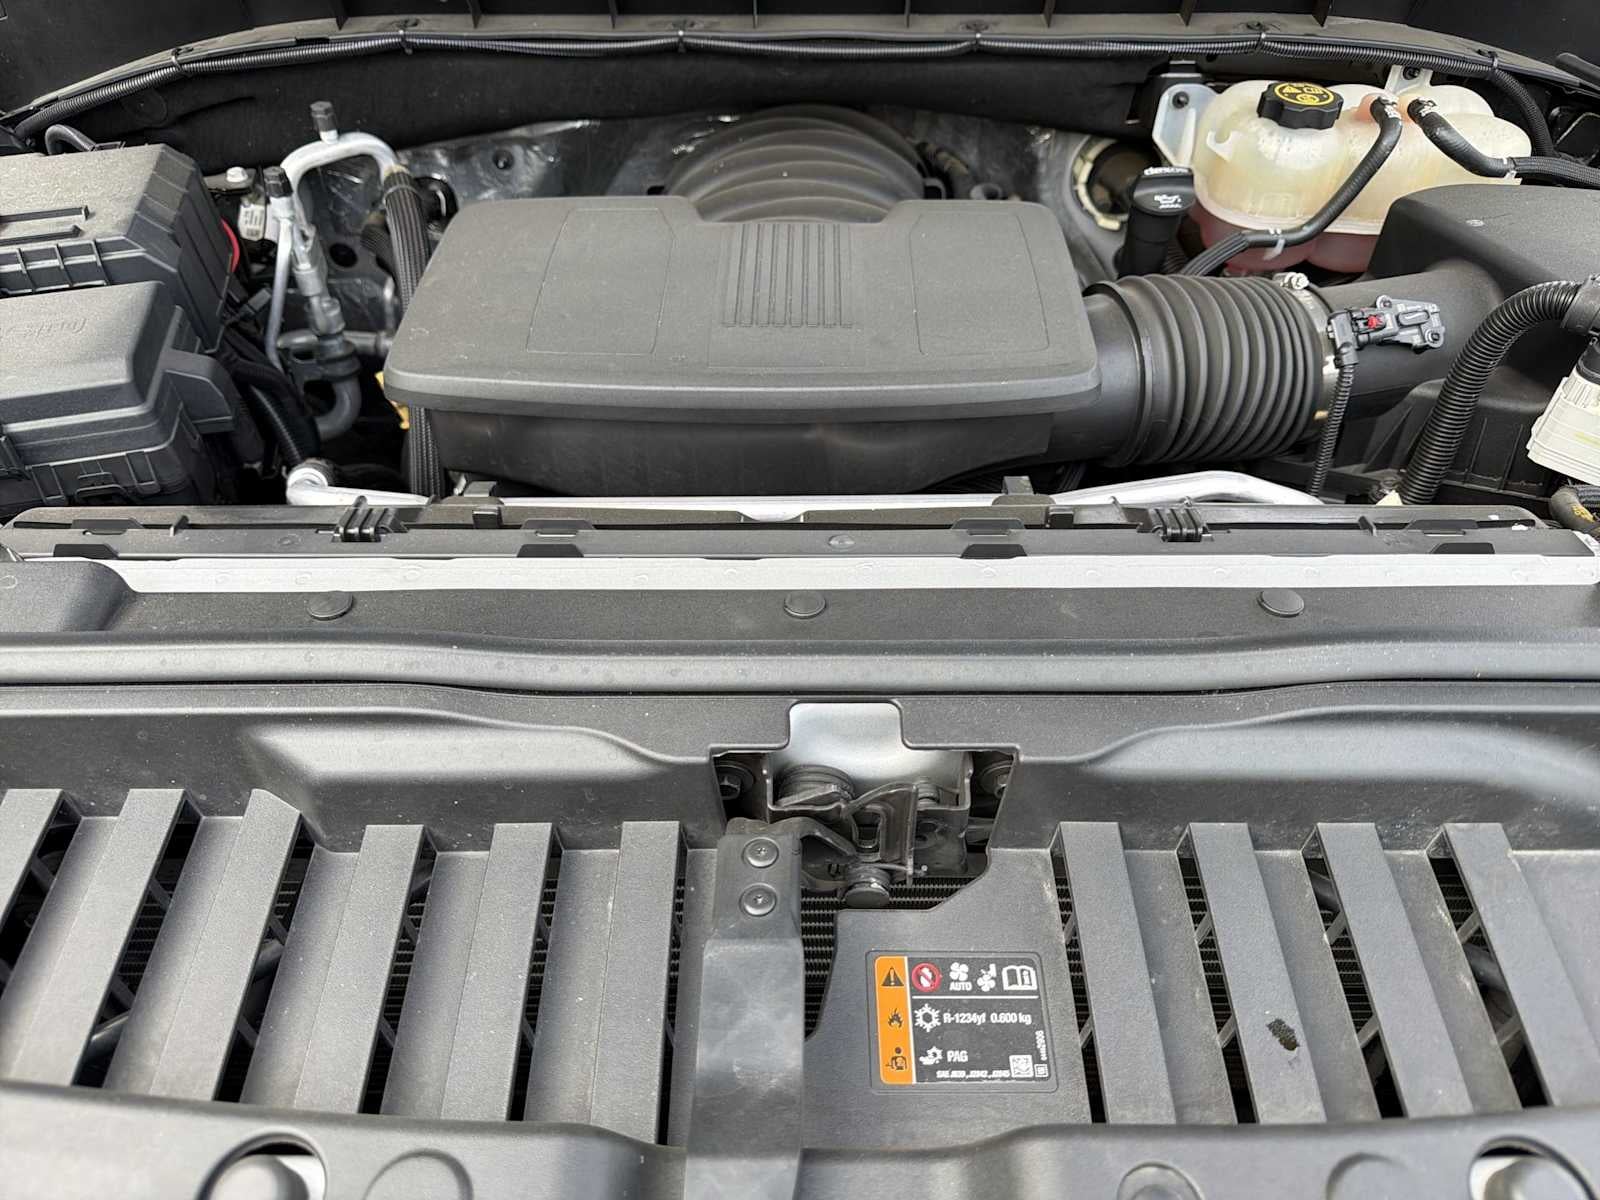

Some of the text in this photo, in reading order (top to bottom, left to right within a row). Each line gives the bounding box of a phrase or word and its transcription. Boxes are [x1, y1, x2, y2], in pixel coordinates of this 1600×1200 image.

[949, 981, 972, 991] AUTO
[942, 1012, 986, 1025] R-1234yf
[1018, 1012, 1032, 1025] kg
[946, 1050, 968, 1062] PAG
